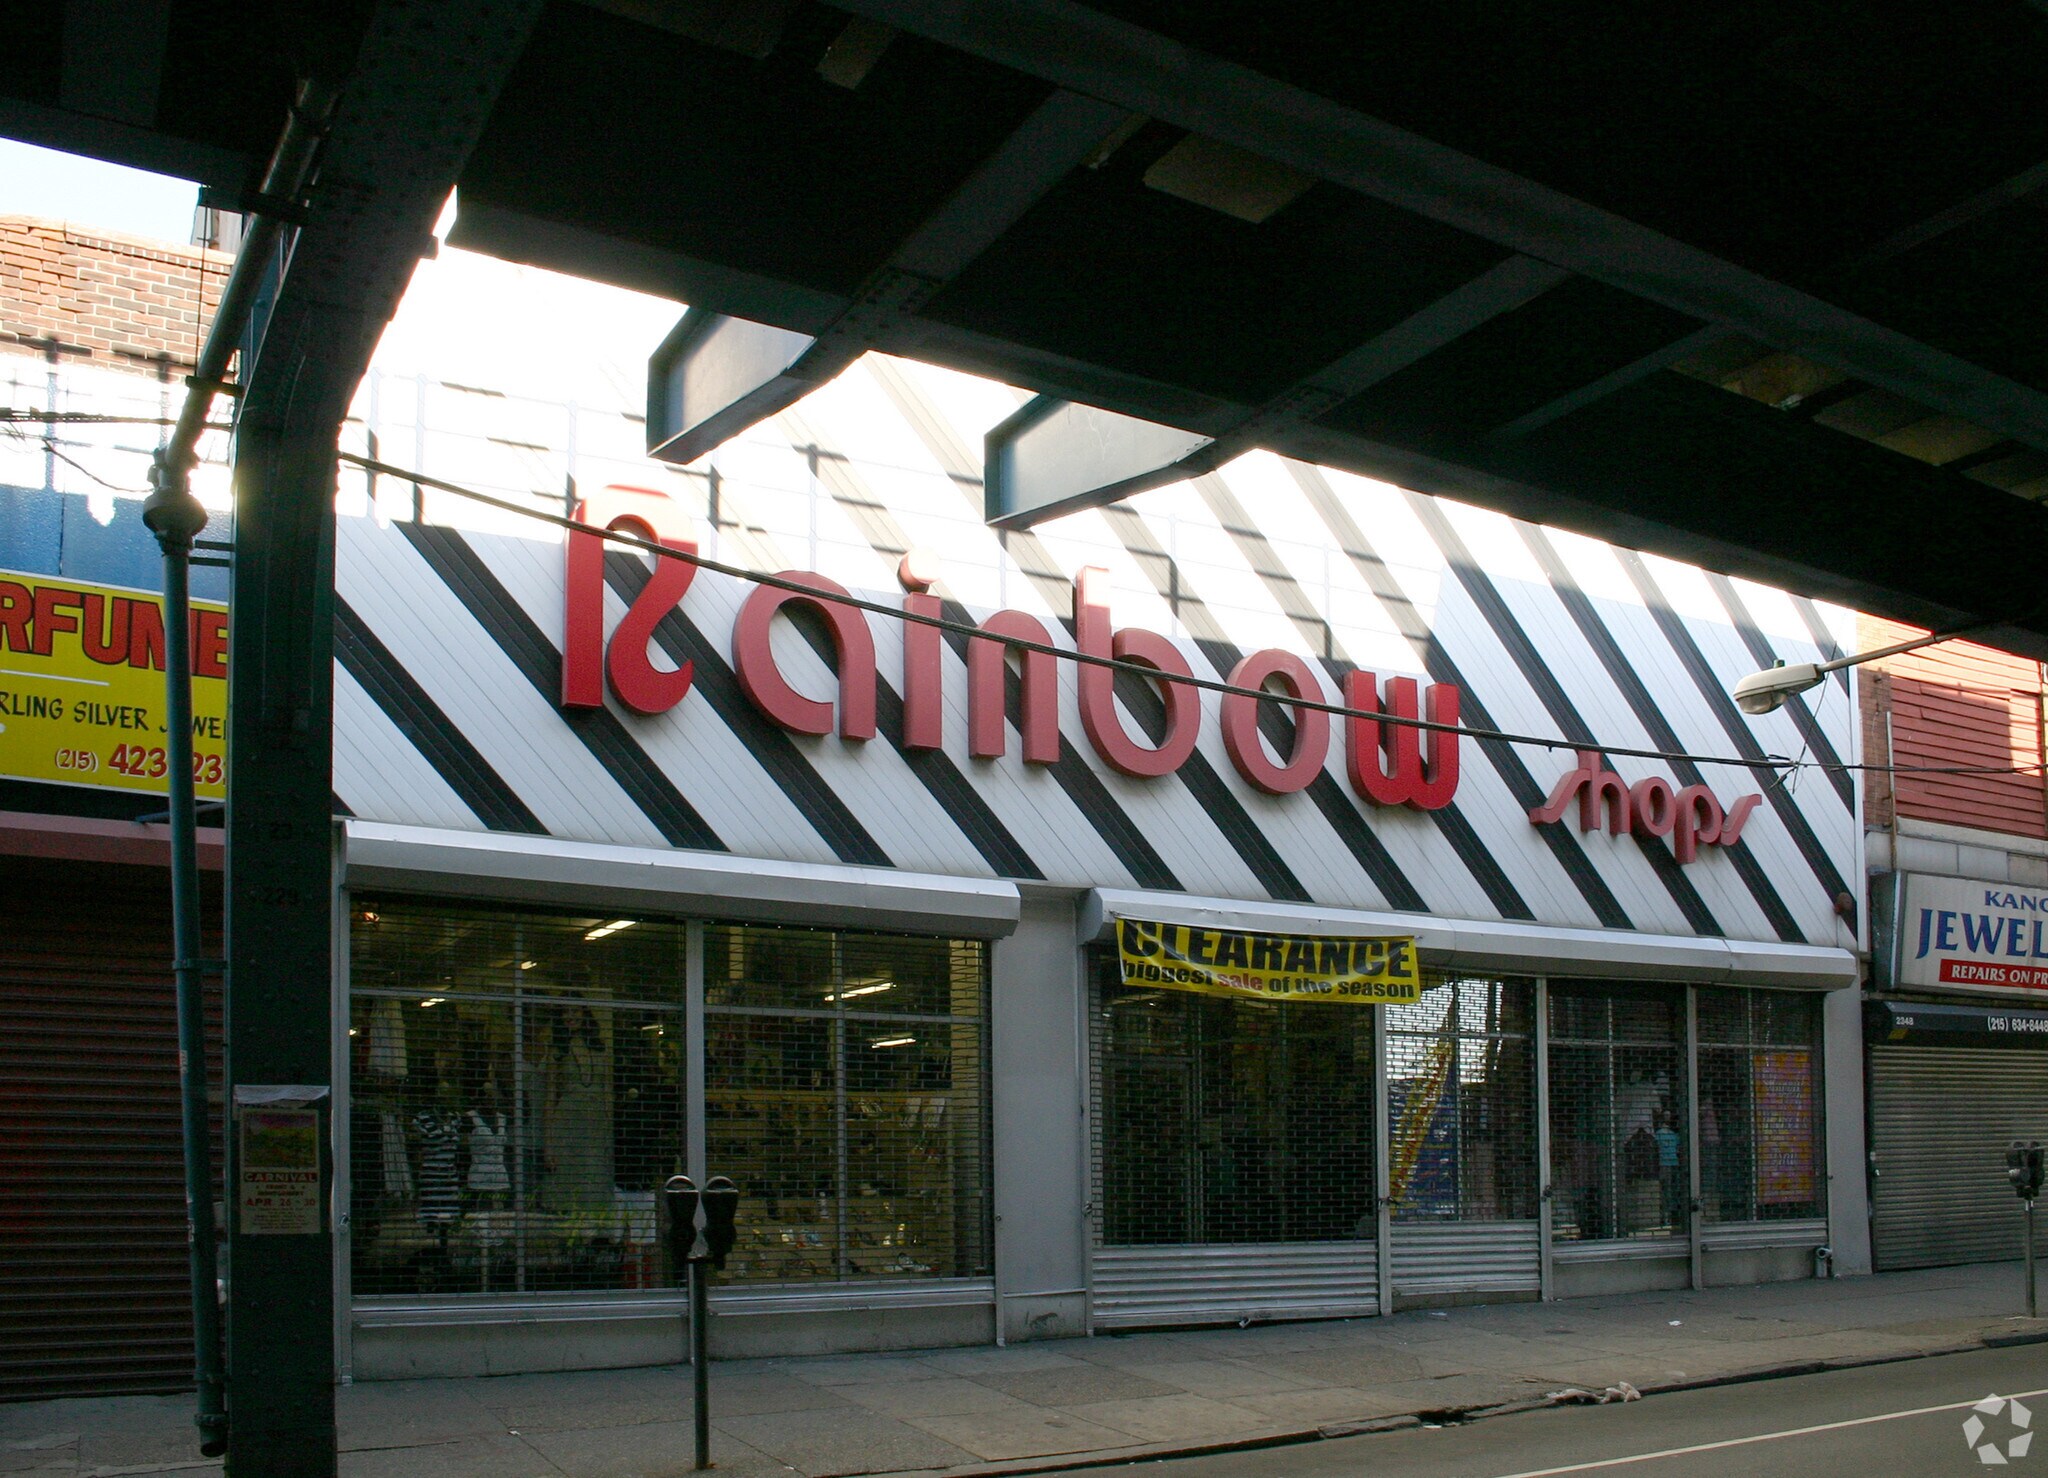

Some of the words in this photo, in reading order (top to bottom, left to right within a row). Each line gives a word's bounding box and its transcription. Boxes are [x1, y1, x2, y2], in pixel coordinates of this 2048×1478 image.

[561, 484, 1459, 812] Rainbow
[74, 701, 149, 731] SILVER
[55, 748, 98, 773] (215)
[1123, 919, 1412, 977] CLEARANCE
[1915, 908, 2048, 959] JEWEL
[1123, 959, 1213, 986] biggest
[1218, 973, 1264, 991] sale
[1269, 976, 1290, 992] of
[1295, 977, 1332, 994] the
[1338, 980, 1414, 998] season
[1952, 964, 2006, 982] REPAIRS
[2010, 969, 2030, 984] ON
[1987, 1015, 2009, 1032] (215)
[245, 1173, 316, 1182] CARNIVAL
